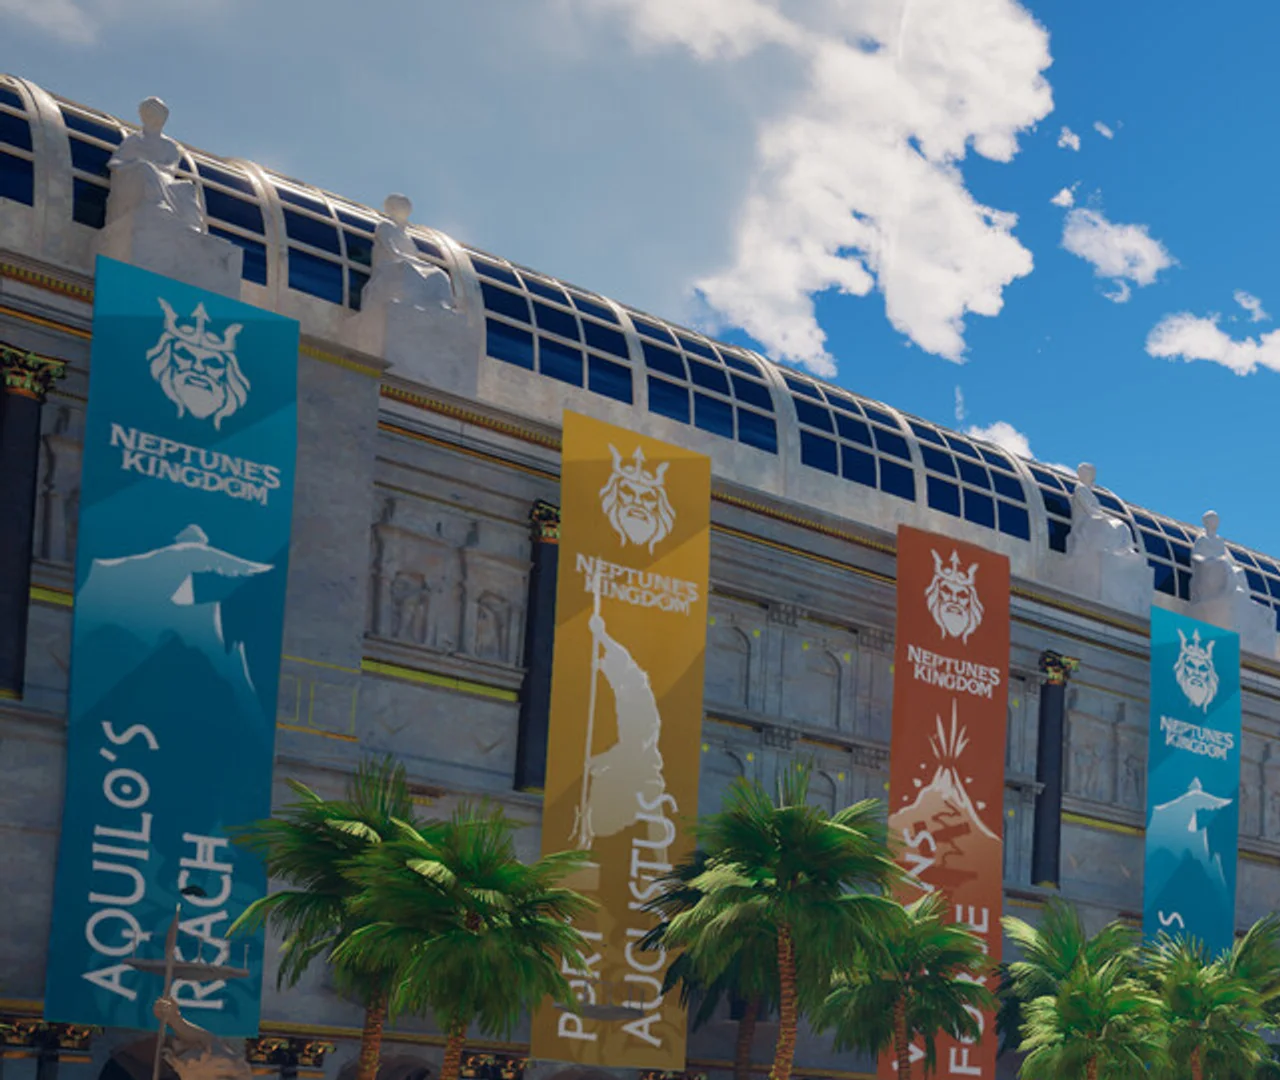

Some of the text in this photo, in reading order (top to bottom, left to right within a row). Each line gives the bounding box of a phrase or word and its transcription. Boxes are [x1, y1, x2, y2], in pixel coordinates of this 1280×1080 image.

[121, 450, 268, 506] KINGDOM
[914, 663, 993, 699] KINGDOM
[81, 720, 160, 1001] AQUILO'S
